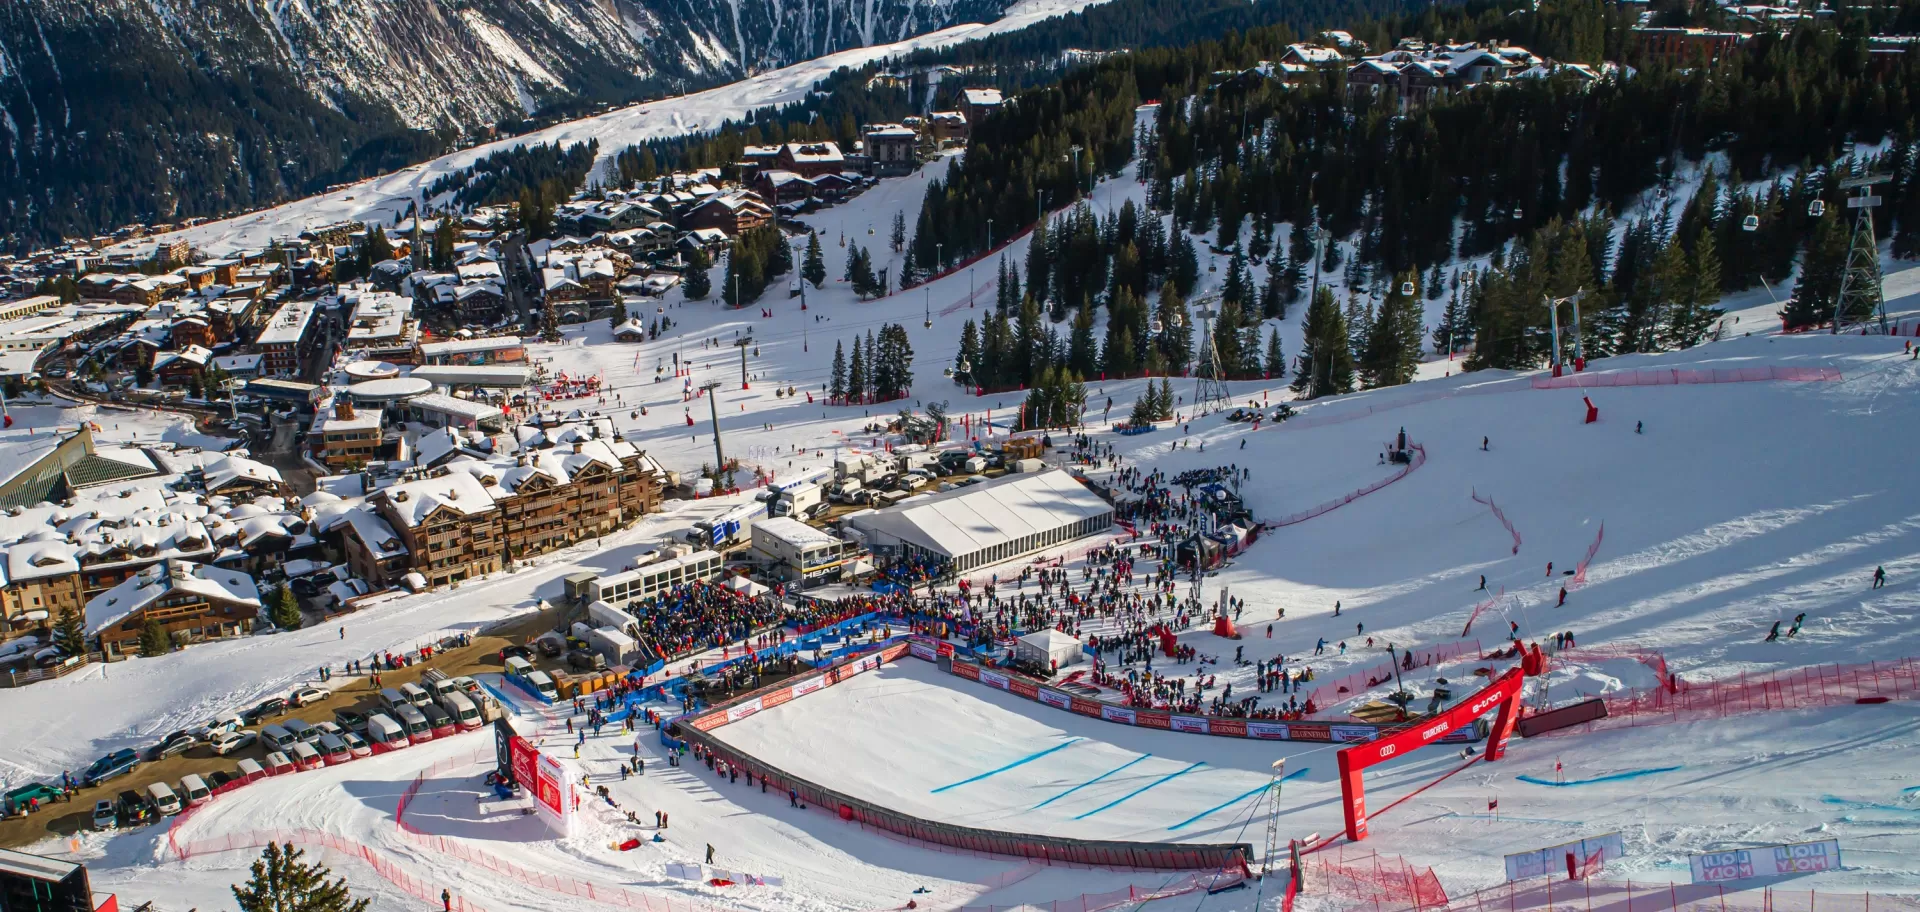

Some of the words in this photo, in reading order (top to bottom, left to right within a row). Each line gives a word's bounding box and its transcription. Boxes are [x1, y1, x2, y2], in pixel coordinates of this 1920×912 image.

[803, 565, 840, 579] HEAD
[1472, 691, 1502, 714] e-tron
[1145, 718, 1170, 728] GENERALI
[1219, 725, 1246, 735] GENERALI
[1300, 730, 1330, 739] GENERALI
[1422, 721, 1450, 740] COURCHEVEL
